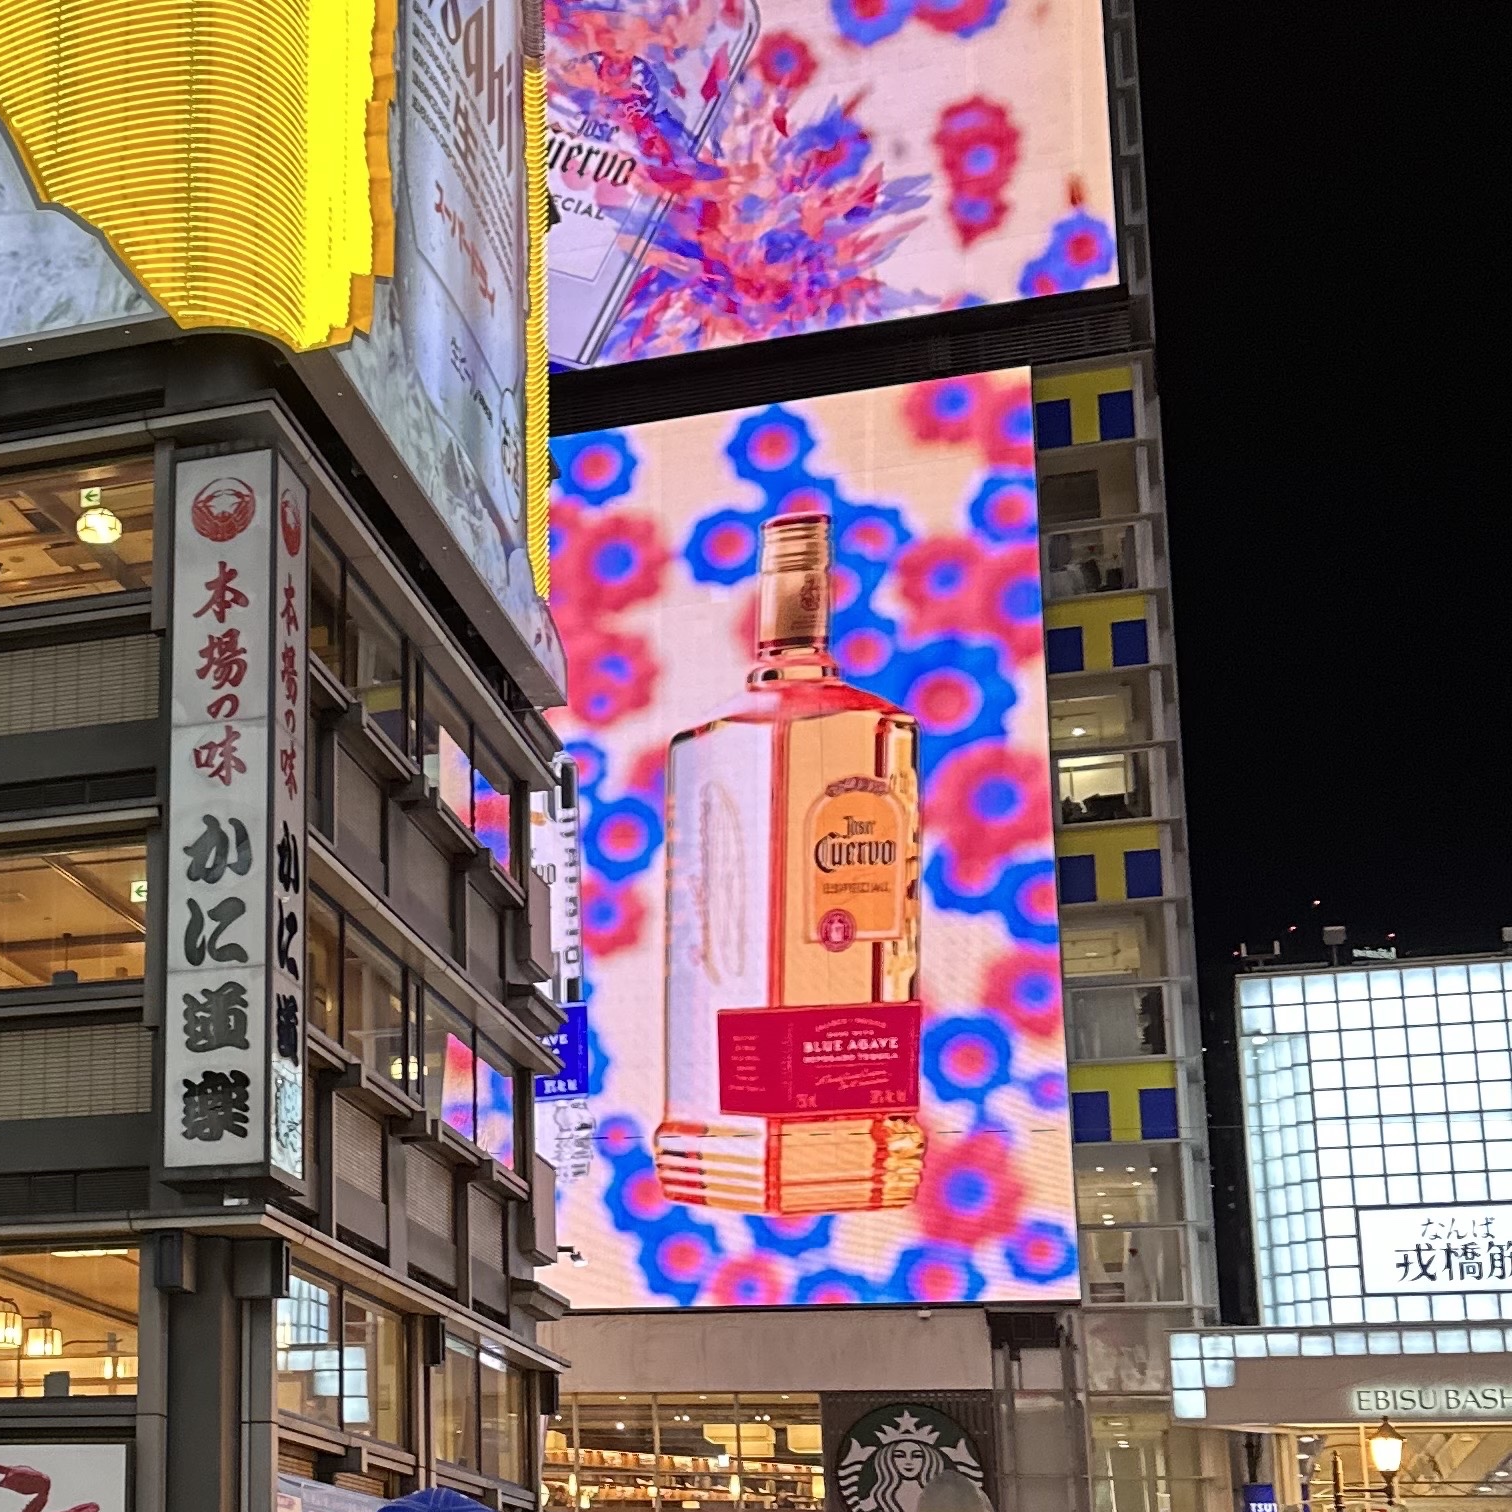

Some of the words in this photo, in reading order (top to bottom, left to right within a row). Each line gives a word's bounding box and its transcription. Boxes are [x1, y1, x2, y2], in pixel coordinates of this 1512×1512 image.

[546, 135, 637, 188] uervo
[192, 560, 250, 787] 本場の味
[813, 831, 897, 874] Cuervo
[802, 1040, 843, 1053] BLUE
[847, 1036, 899, 1050] AGAVE
[1421, 1217, 1495, 1240] なんば
[1394, 1241, 1512, 1282] 戎橋筋
[1356, 1388, 1438, 1411] EBISU
